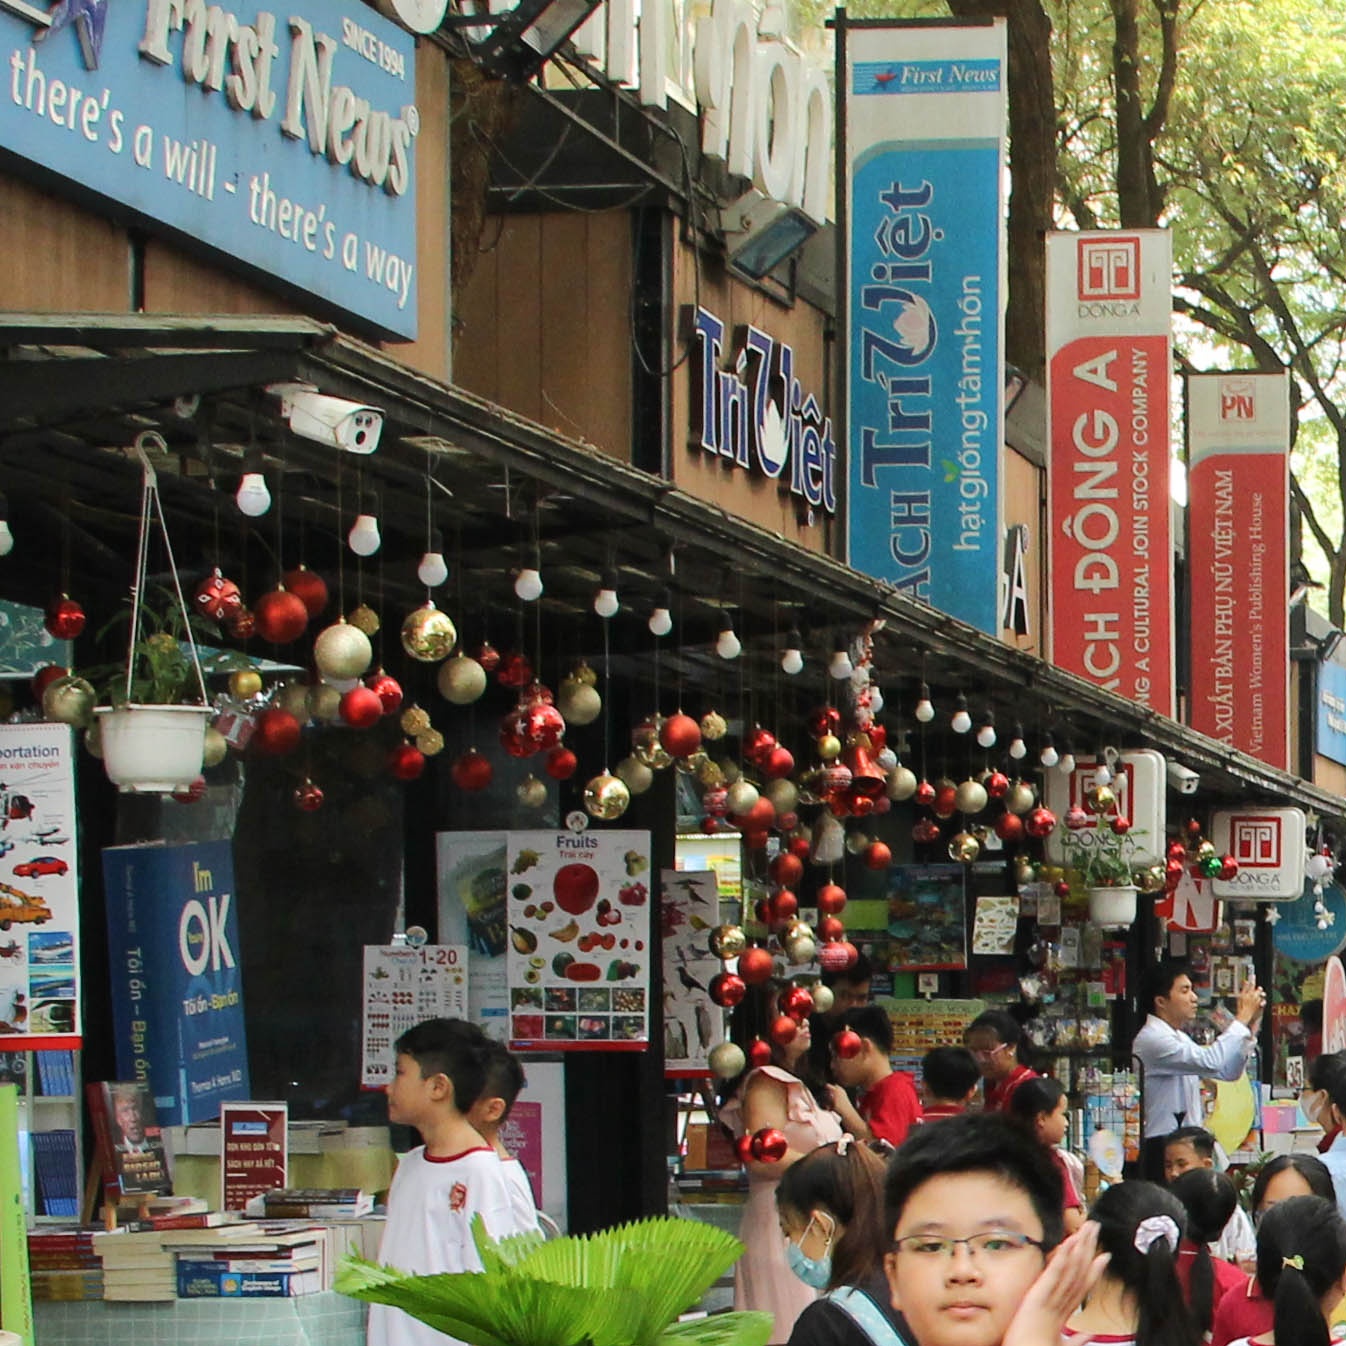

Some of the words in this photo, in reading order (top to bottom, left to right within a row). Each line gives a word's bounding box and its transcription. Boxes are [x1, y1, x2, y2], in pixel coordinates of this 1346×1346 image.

[342, 17, 378, 60] SINCE
[377, 30, 405, 80] 1994
[900, 66, 943, 84] First
[10, 48, 124, 153] there's
[134, 125, 152, 169] a
[164, 135, 217, 201] will
[249, 172, 334, 261] there's
[343, 232, 357, 272] a
[365, 241, 413, 310] way
[1073, 350, 1117, 392] A
[1132, 347, 1150, 445] COMPANY
[1062, 409, 1120, 594] ĐÔNG
[1132, 450, 1150, 513] STOCK
[1214, 469, 1234, 512] NAM
[1132, 519, 1151, 560] JOIN
[1250, 493, 1263, 542] House
[1132, 563, 1151, 653] CULTURAL
[1249, 543, 1266, 628] Publishing
[1250, 630, 1263, 696] Women's
[1249, 698, 1263, 754] Vietnam
[556, 835, 598, 850] Fruits
[180, 895, 235, 976] OK
